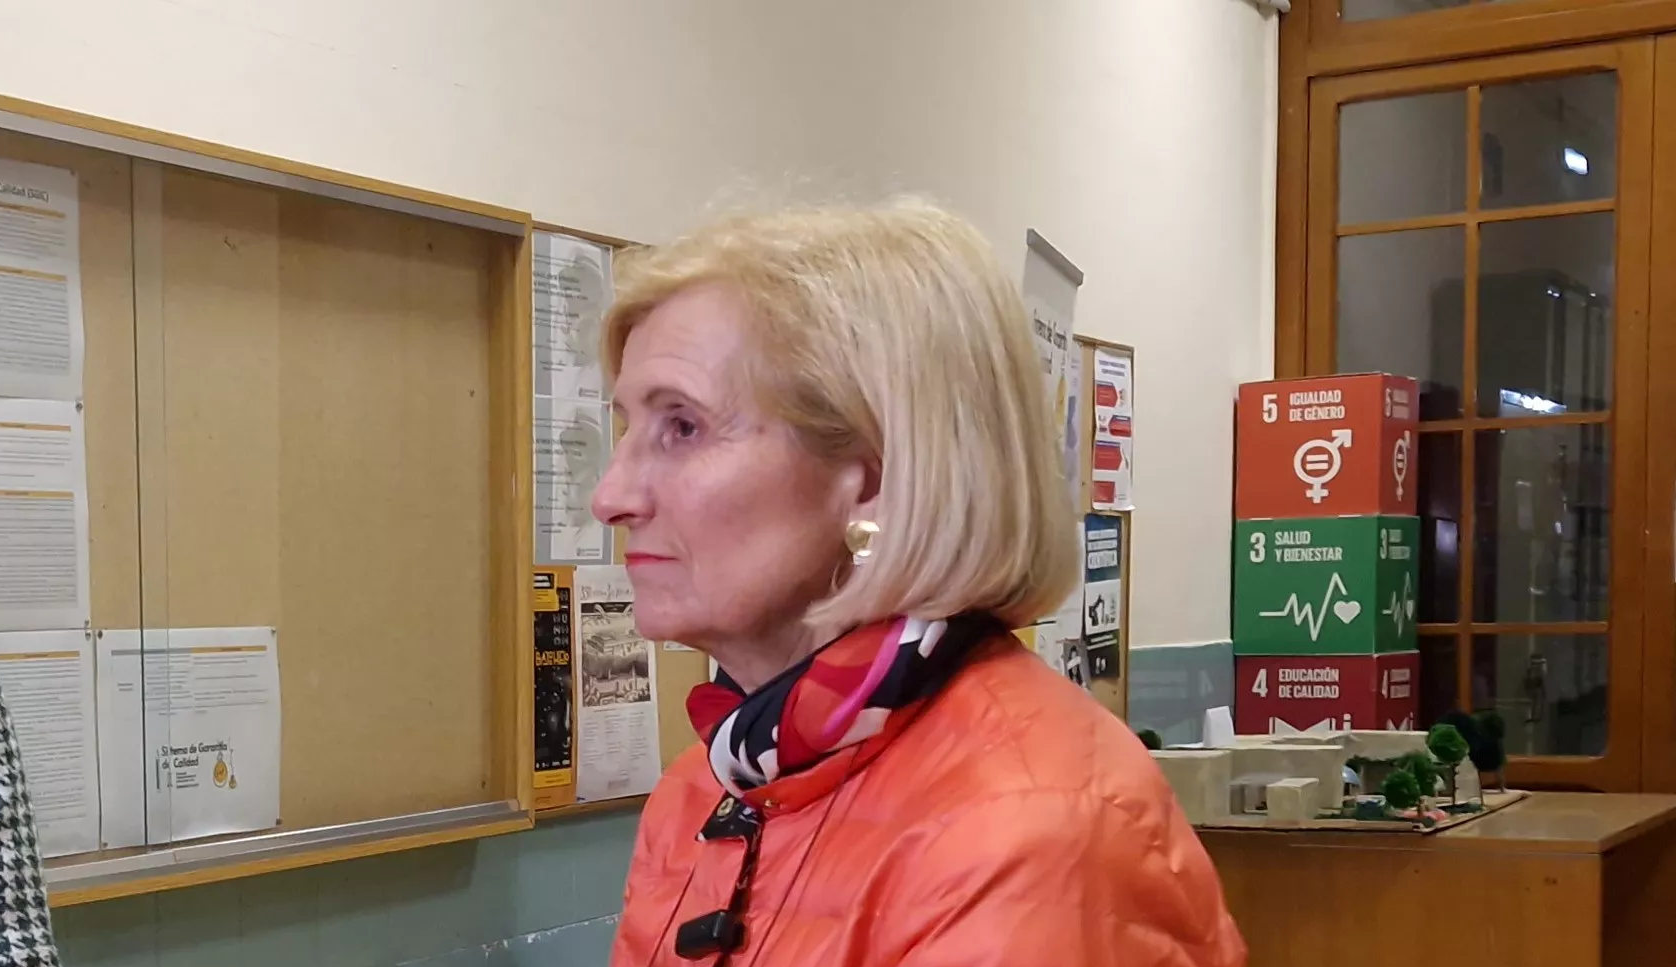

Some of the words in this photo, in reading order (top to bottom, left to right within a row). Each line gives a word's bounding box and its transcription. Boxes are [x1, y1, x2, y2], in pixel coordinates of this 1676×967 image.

[1289, 389, 1342, 406] IGUALDAD
[1263, 393, 1279, 424] 5
[1289, 407, 1303, 422] DE
[1304, 405, 1346, 421] GÉNERO
[1274, 530, 1312, 546] SALUD
[1250, 532, 1266, 563] 3
[1275, 548, 1283, 562] Y
[1283, 547, 1343, 562] BIENESTAR
[1278, 666, 1340, 682] EDUCACIÓN
[1252, 668, 1268, 698] 4
[1278, 684, 1293, 698] DE
[1293, 684, 1340, 698] CALIDAD
